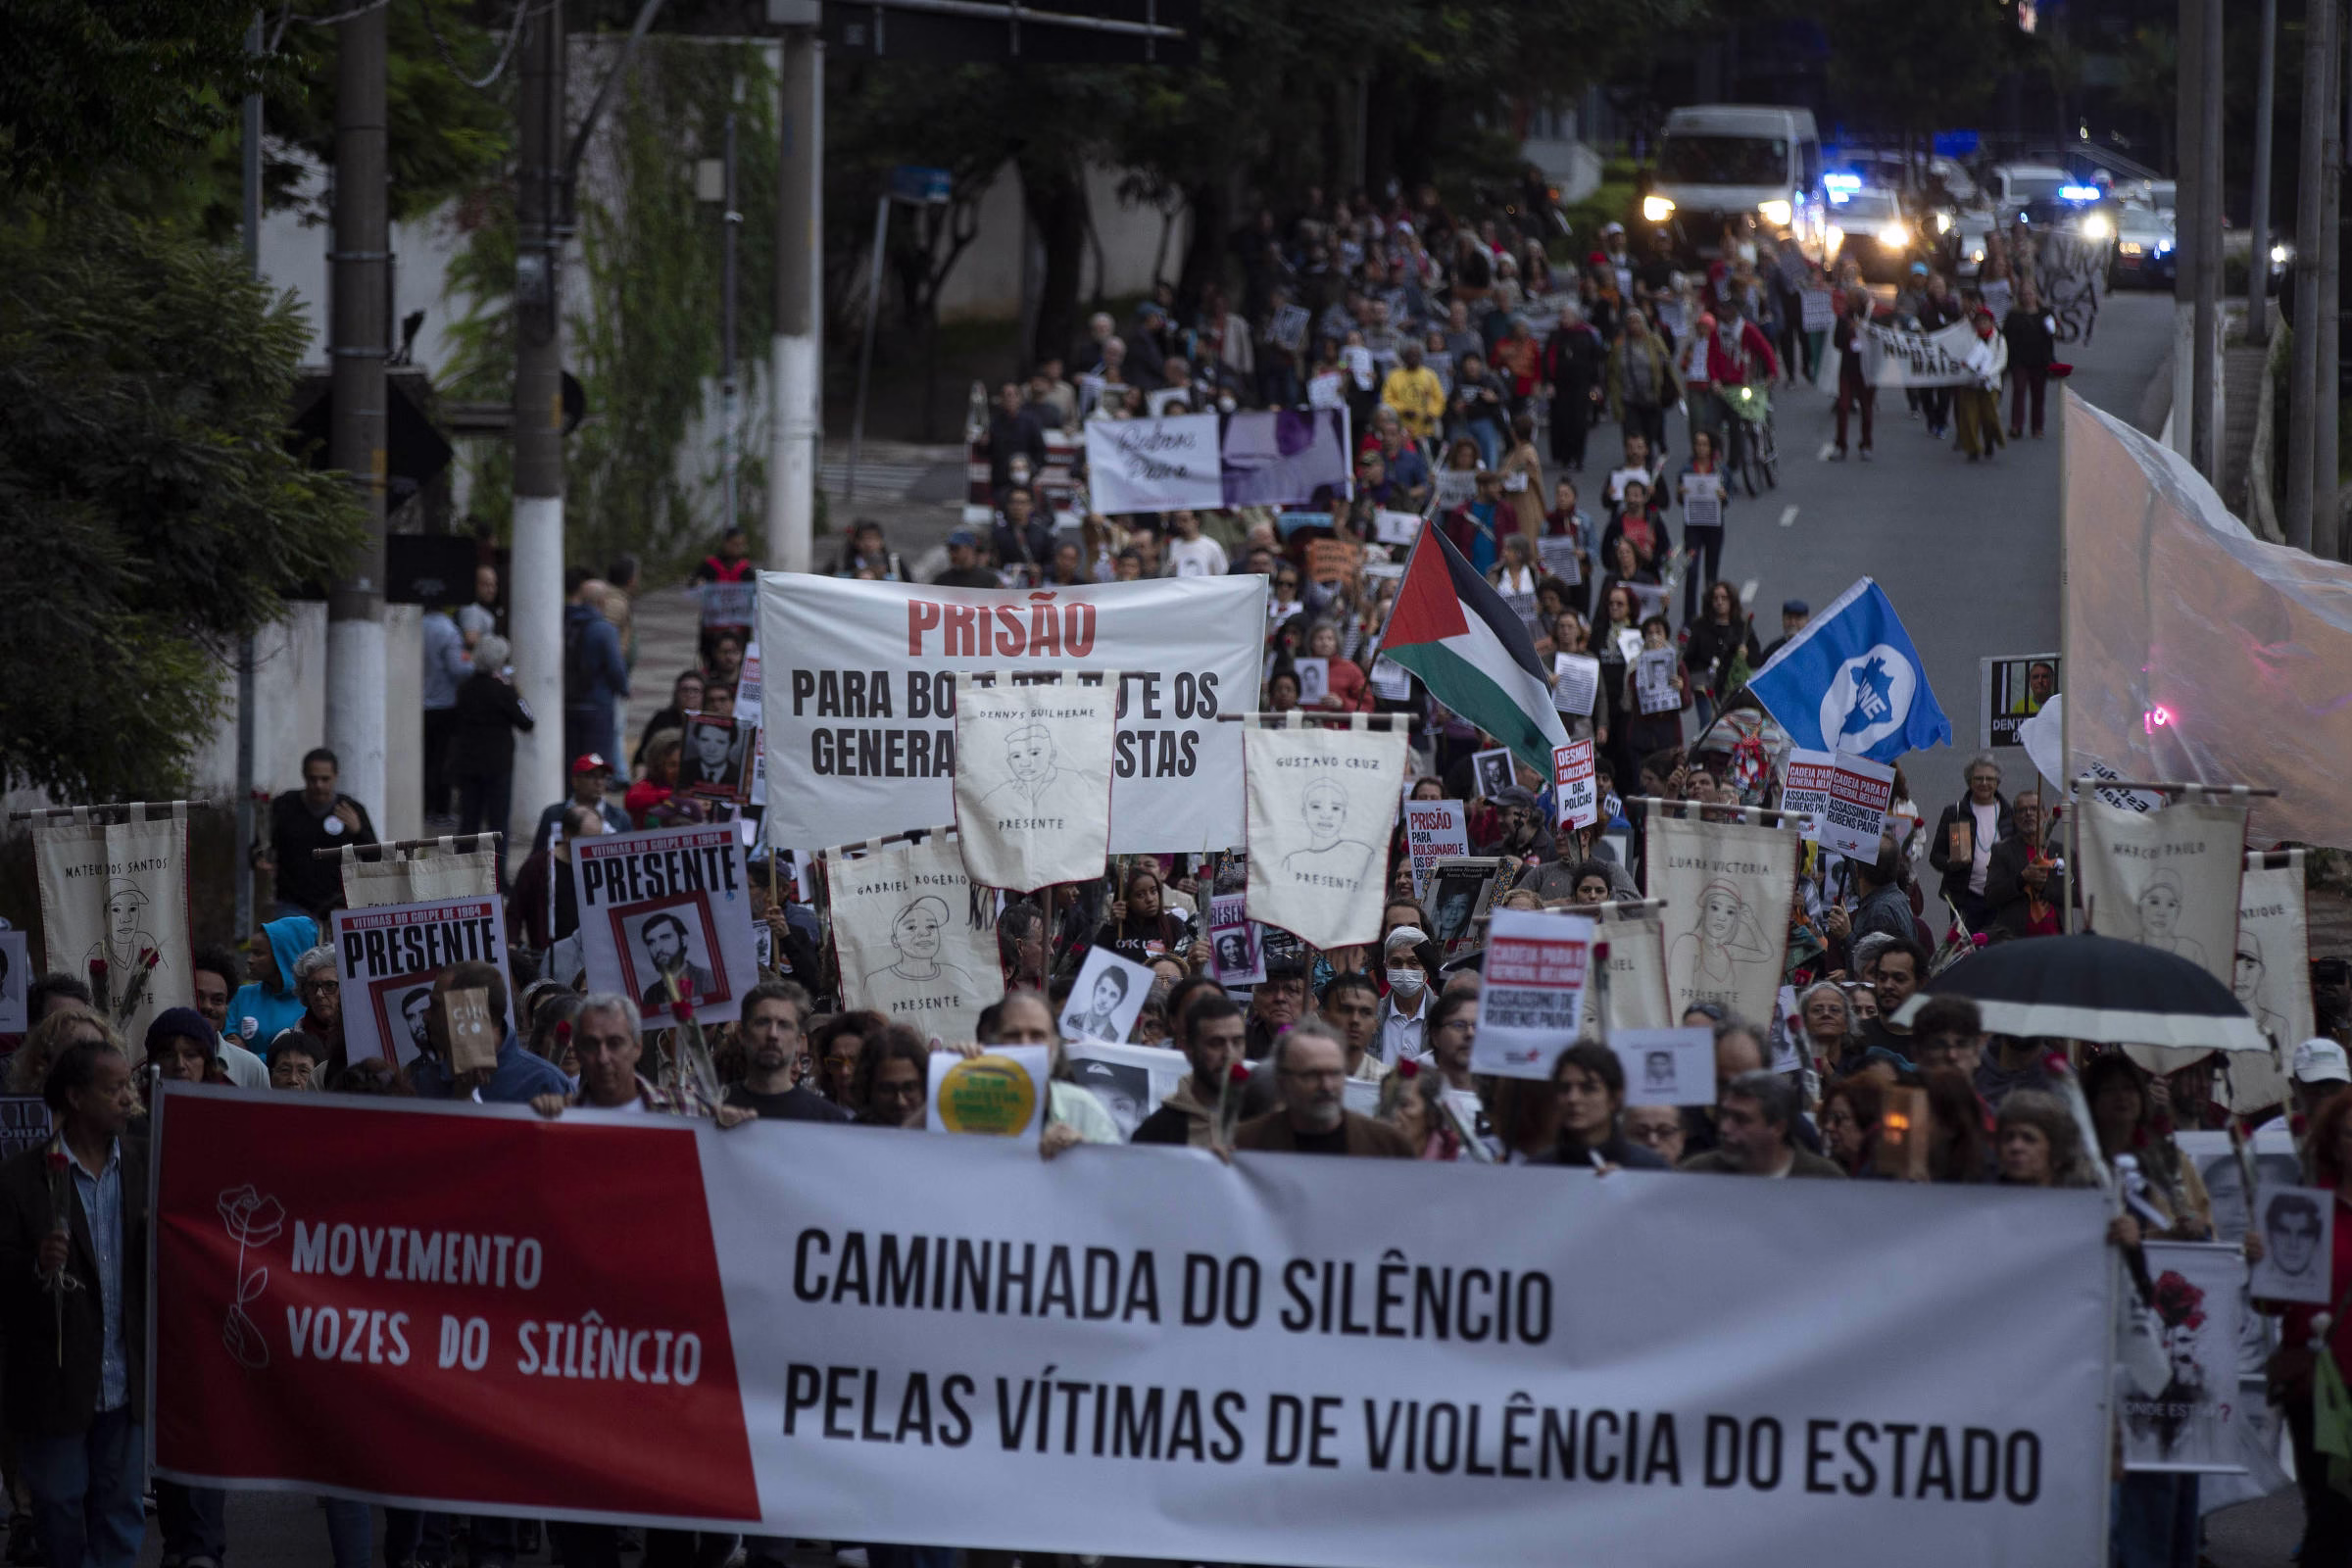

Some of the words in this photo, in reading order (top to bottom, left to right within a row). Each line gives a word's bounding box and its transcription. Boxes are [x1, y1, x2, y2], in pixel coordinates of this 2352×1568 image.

[908, 592, 1097, 658] PRISÃO
[792, 669, 893, 718] PARA
[1175, 671, 1219, 720] OS
[979, 708, 1025, 719] DENNYS
[1031, 708, 1096, 720] GUILHERME
[811, 728, 956, 779] GENERA
[1276, 757, 1339, 768] GUSTAVO
[1346, 758, 1380, 770] CRUZ
[1557, 743, 1591, 767] DESMILI
[1558, 761, 1592, 781] TARIZAÇÃO
[1789, 765, 1816, 778] CADEIA
[1572, 781, 1585, 795] DAS
[1788, 776, 1815, 788] GENERAL
[1834, 772, 1859, 790] CADEIA
[1861, 780, 1880, 795] PARA
[1882, 785, 1888, 797] O
[1786, 790, 1826, 804] ASSASSINO
[1832, 784, 1859, 801] GENERAL
[1859, 792, 1886, 808] BELHAM
[1785, 801, 1814, 813] RUBENS
[1829, 798, 1870, 820] ASSASSINO
[1870, 810, 1883, 824] DE
[999, 817, 1065, 832] PRESENTE
[1410, 808, 1452, 830] PRISÃO
[1826, 810, 1857, 829] RUBENS
[1857, 819, 1880, 836] PAIVA
[634, 840, 648, 853] DO
[650, 837, 681, 852] GOLPE
[682, 835, 695, 847] DE
[696, 832, 722, 847] 1964
[1411, 831, 1432, 844] PARA
[1412, 843, 1458, 856] BOLSONARO
[1458, 843, 1465, 856] E
[2164, 841, 2206, 857] PAULO
[65, 863, 103, 879] MATEUS
[105, 862, 122, 875] DOS
[127, 858, 168, 874] SANTOS
[1414, 857, 1425, 868] OS
[1669, 856, 1709, 871] LUARA
[1713, 860, 1770, 877] VICTORIA
[581, 845, 739, 906] PRESENTE
[1296, 872, 1359, 893] PRESENTE
[858, 880, 909, 896] GABRIEL
[394, 911, 409, 926] DO
[411, 907, 441, 924] GOLPE
[442, 906, 457, 920] DE
[457, 905, 483, 919] 1964
[343, 917, 499, 980] PRESENTE
[893, 995, 960, 1013] PRESENTE
[292, 1219, 543, 1291] MOVIMENTO
[794, 1228, 1161, 1324] CAMINHADA
[1182, 1252, 1260, 1330] DO
[1280, 1249, 1553, 1346] SILÊNCIO
[286, 1304, 411, 1366] VOZES
[438, 1314, 489, 1371] DO
[516, 1308, 703, 1386] SILÊNCIO
[783, 1363, 975, 1448] PELAS
[997, 1365, 1247, 1464] VÍTIMAS
[1265, 1393, 1344, 1469] DE
[1363, 1391, 1683, 1486] VIOLÊNCIA
[1703, 1414, 1783, 1492] DO
[1805, 1419, 2041, 1506] ESTADO
